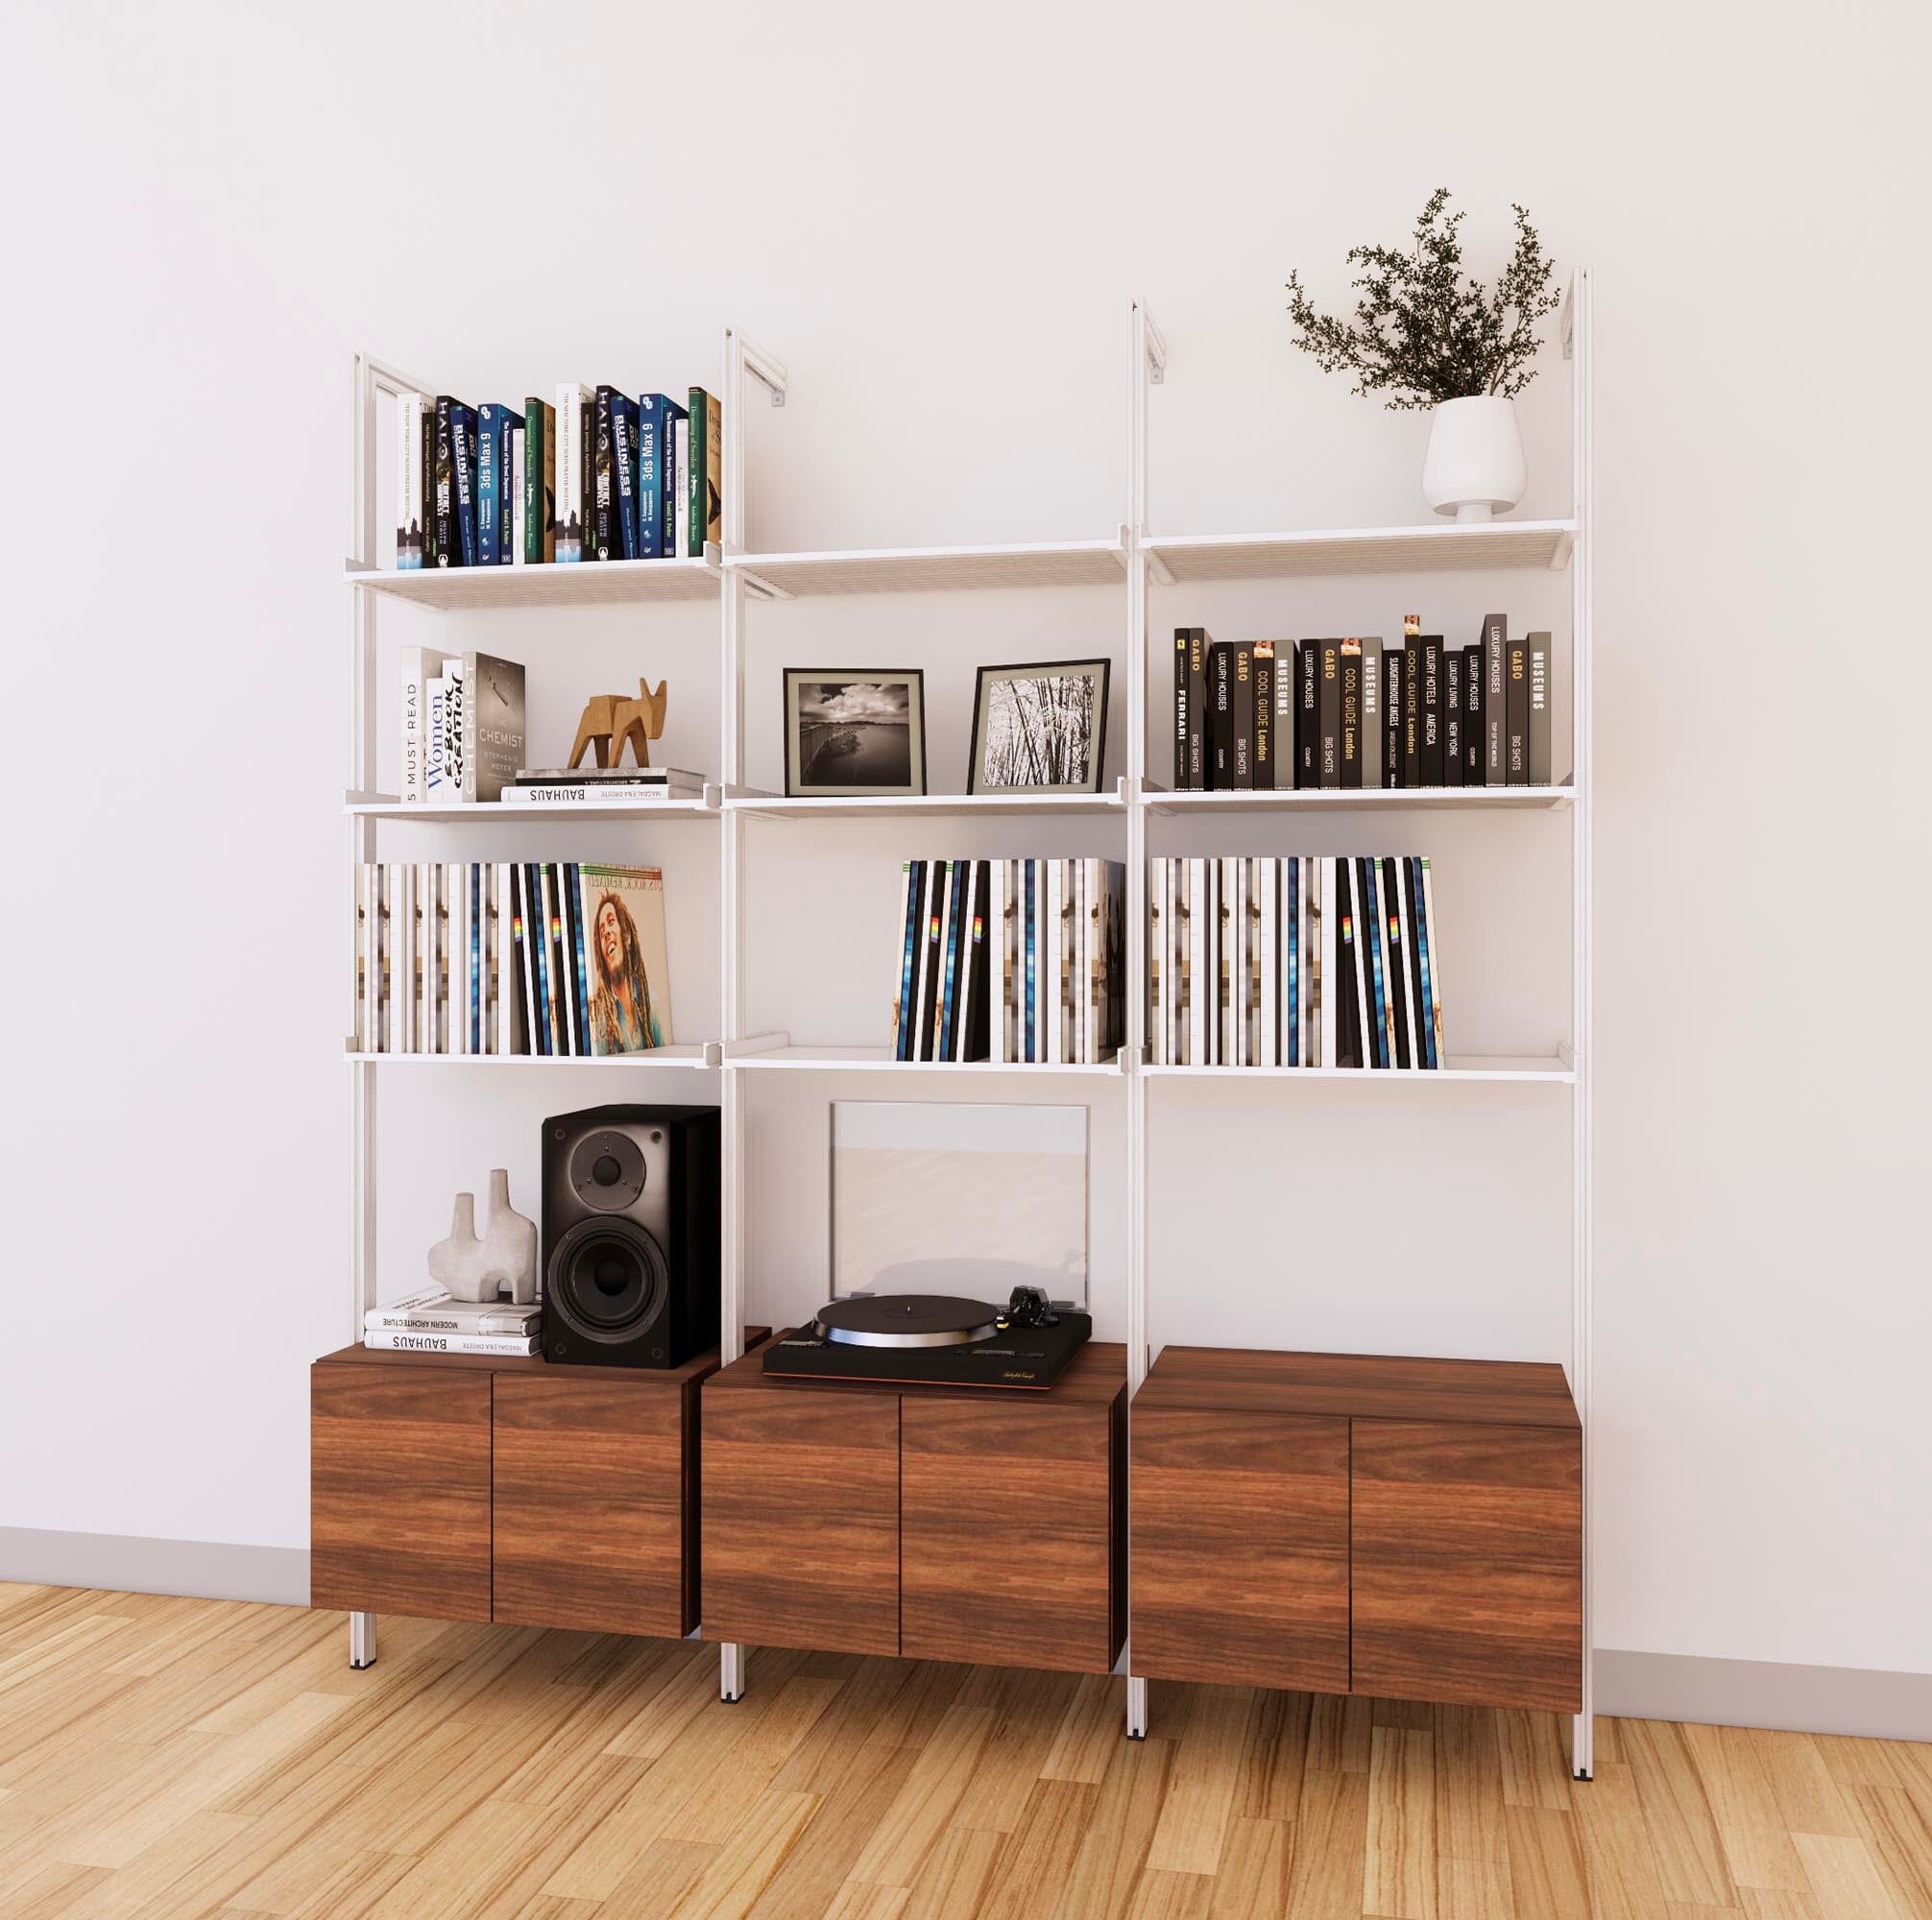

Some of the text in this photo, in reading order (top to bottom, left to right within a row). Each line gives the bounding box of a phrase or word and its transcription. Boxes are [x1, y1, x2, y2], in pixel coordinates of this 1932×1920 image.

[439, 401, 447, 460] HALO
[598, 392, 608, 450] HALO
[642, 433, 653, 457] Max
[457, 424, 470, 505] BUSINESS
[480, 443, 491, 467] Max
[480, 468, 491, 489] 3ds
[617, 414, 631, 496] BUSINESS
[642, 460, 653, 480] 3ds
[1192, 639, 1200, 671] GABO
[1218, 652, 1226, 711] LUXURY HOUSES
[1238, 652, 1247, 682] GABO
[1305, 649, 1314, 708] LUXURY HOUSES
[1324, 649, 1335, 679] GABO
[1469, 655, 1479, 711] LUXURY HOUSES
[1491, 626, 1500, 693] LUXURY HOUSES
[1512, 650, 1523, 680] GABO
[1533, 652, 1544, 709] MUSEUMS
[1277, 660, 1288, 715] MUSEUMS
[1345, 668, 1356, 759] COOL GUIDE London
[1365, 657, 1376, 714] MUSEUMS
[1426, 645, 1436, 746] LUXURY HOTELS AMERICA
[1449, 660, 1458, 756] LUXURY LIVING NEW YORK
[427, 695, 443, 789] Women
[452, 672, 463, 788] CREATION
[466, 660, 475, 795] CHEMIST
[479, 729, 523, 749] CHEMIST
[1258, 670, 1268, 761] COOL GUIDE London
[1238, 738, 1246, 775] BIG SHOTS
[1324, 736, 1334, 774] BIG SHOTS
[1511, 735, 1521, 771] BIG SHOTS
[530, 789, 585, 801] BAUHAUS
[383, 1318, 458, 1330] MODERN ARCHITECTURE
[393, 1335, 447, 1350] BAUHAUS
